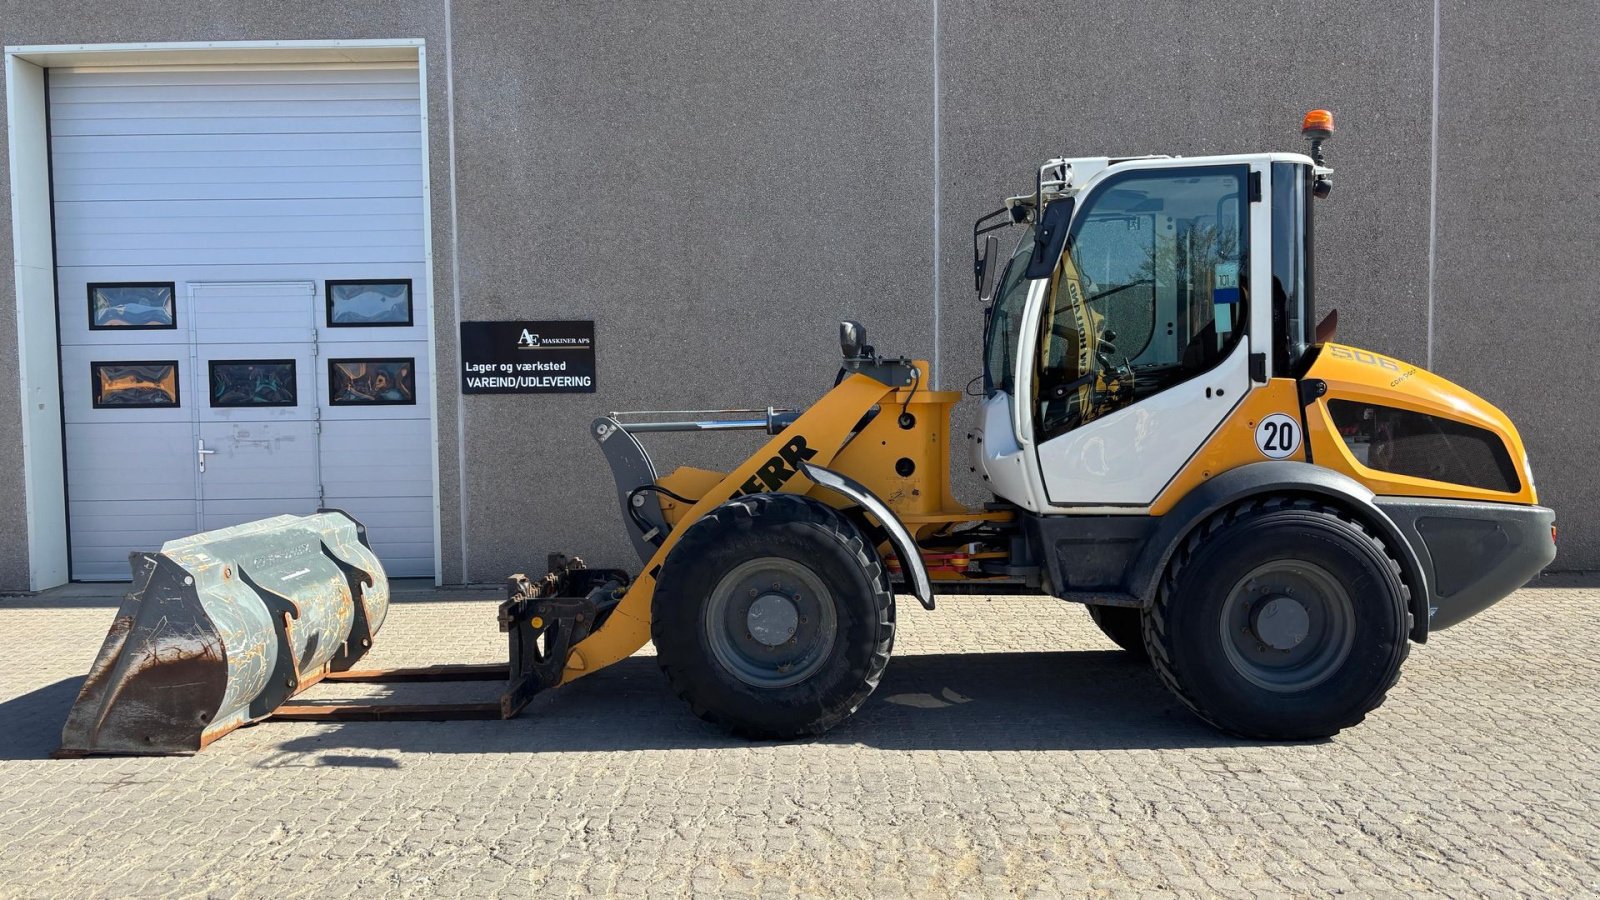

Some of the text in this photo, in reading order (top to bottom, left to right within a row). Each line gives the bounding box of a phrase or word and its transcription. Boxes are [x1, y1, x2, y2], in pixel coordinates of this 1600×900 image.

[465, 361, 567, 374] Lager og værksted
[1329, 344, 1400, 373] 506
[466, 376, 592, 389] VAREIND/UDLEVERING
[1263, 421, 1293, 451] 20
